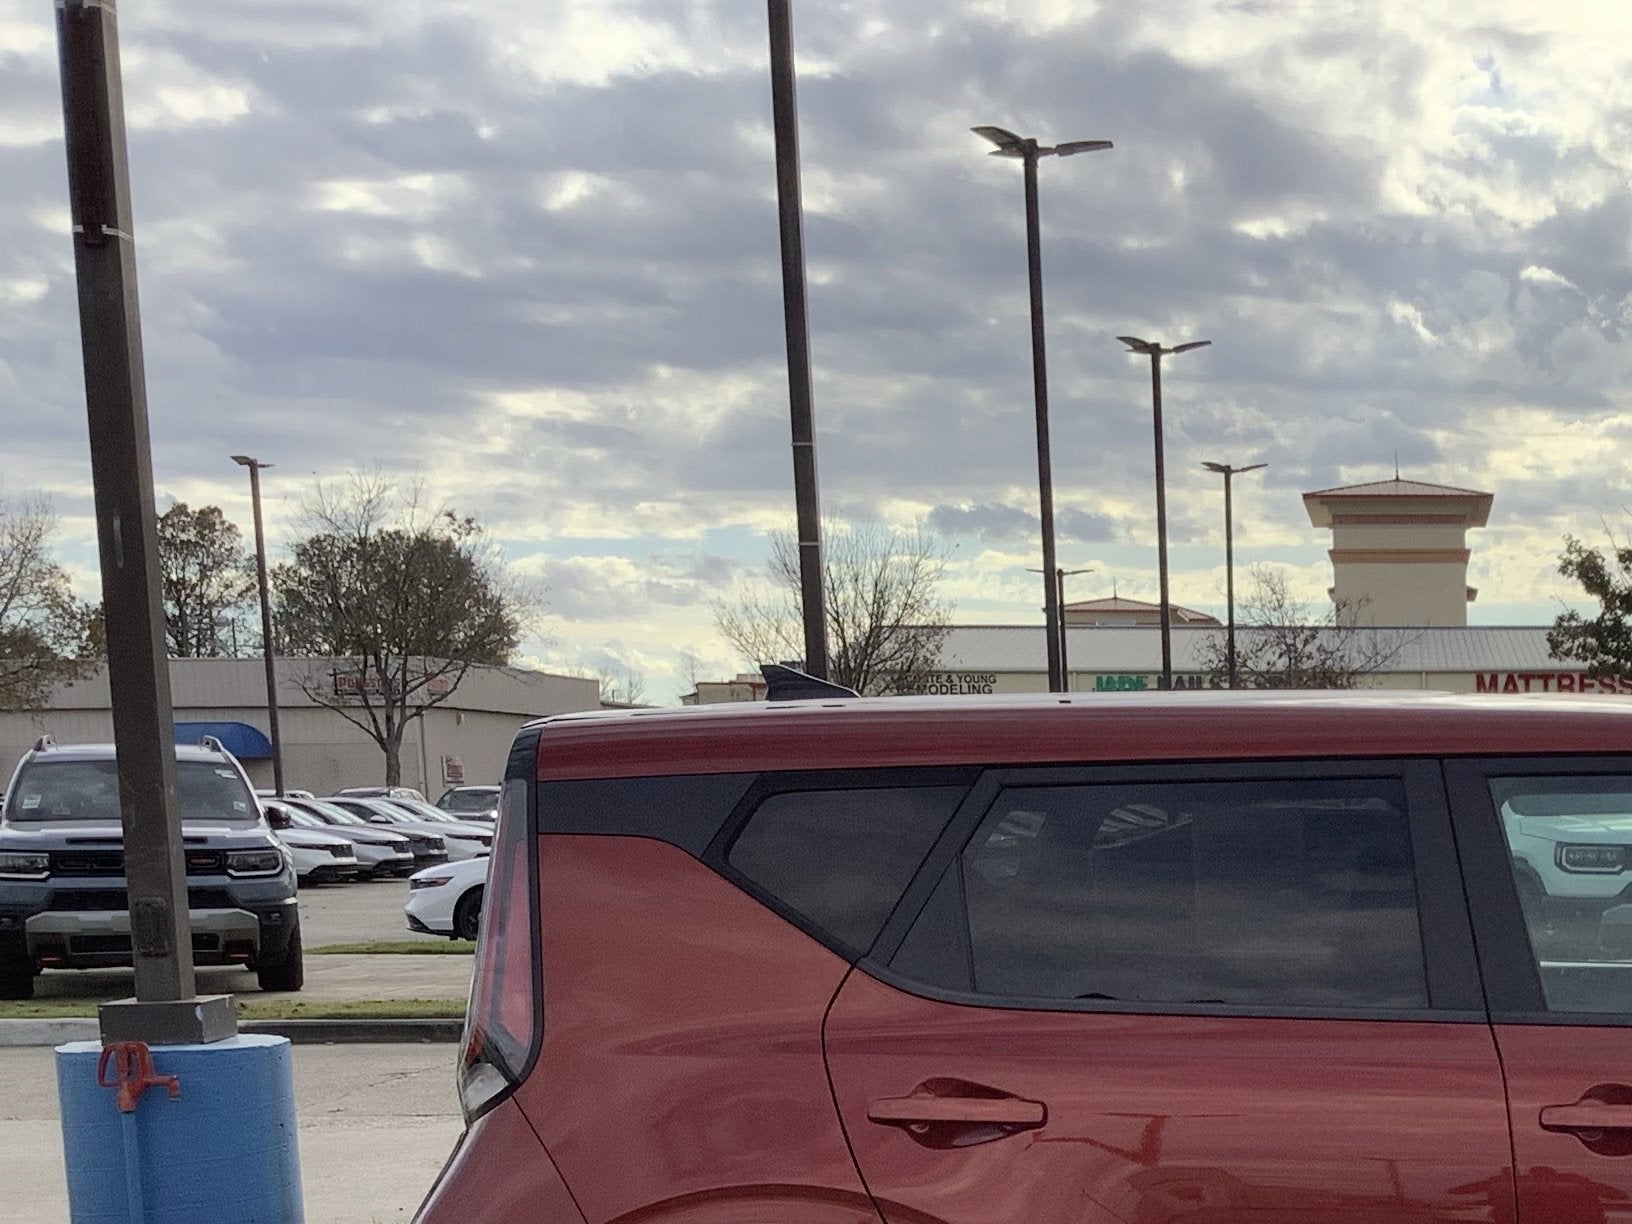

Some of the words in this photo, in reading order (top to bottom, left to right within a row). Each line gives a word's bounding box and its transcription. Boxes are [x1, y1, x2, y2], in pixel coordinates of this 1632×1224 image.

[956, 674, 997, 684] YOUNG
[1096, 675, 1145, 692] JADE
[901, 684, 993, 695] MODELING
